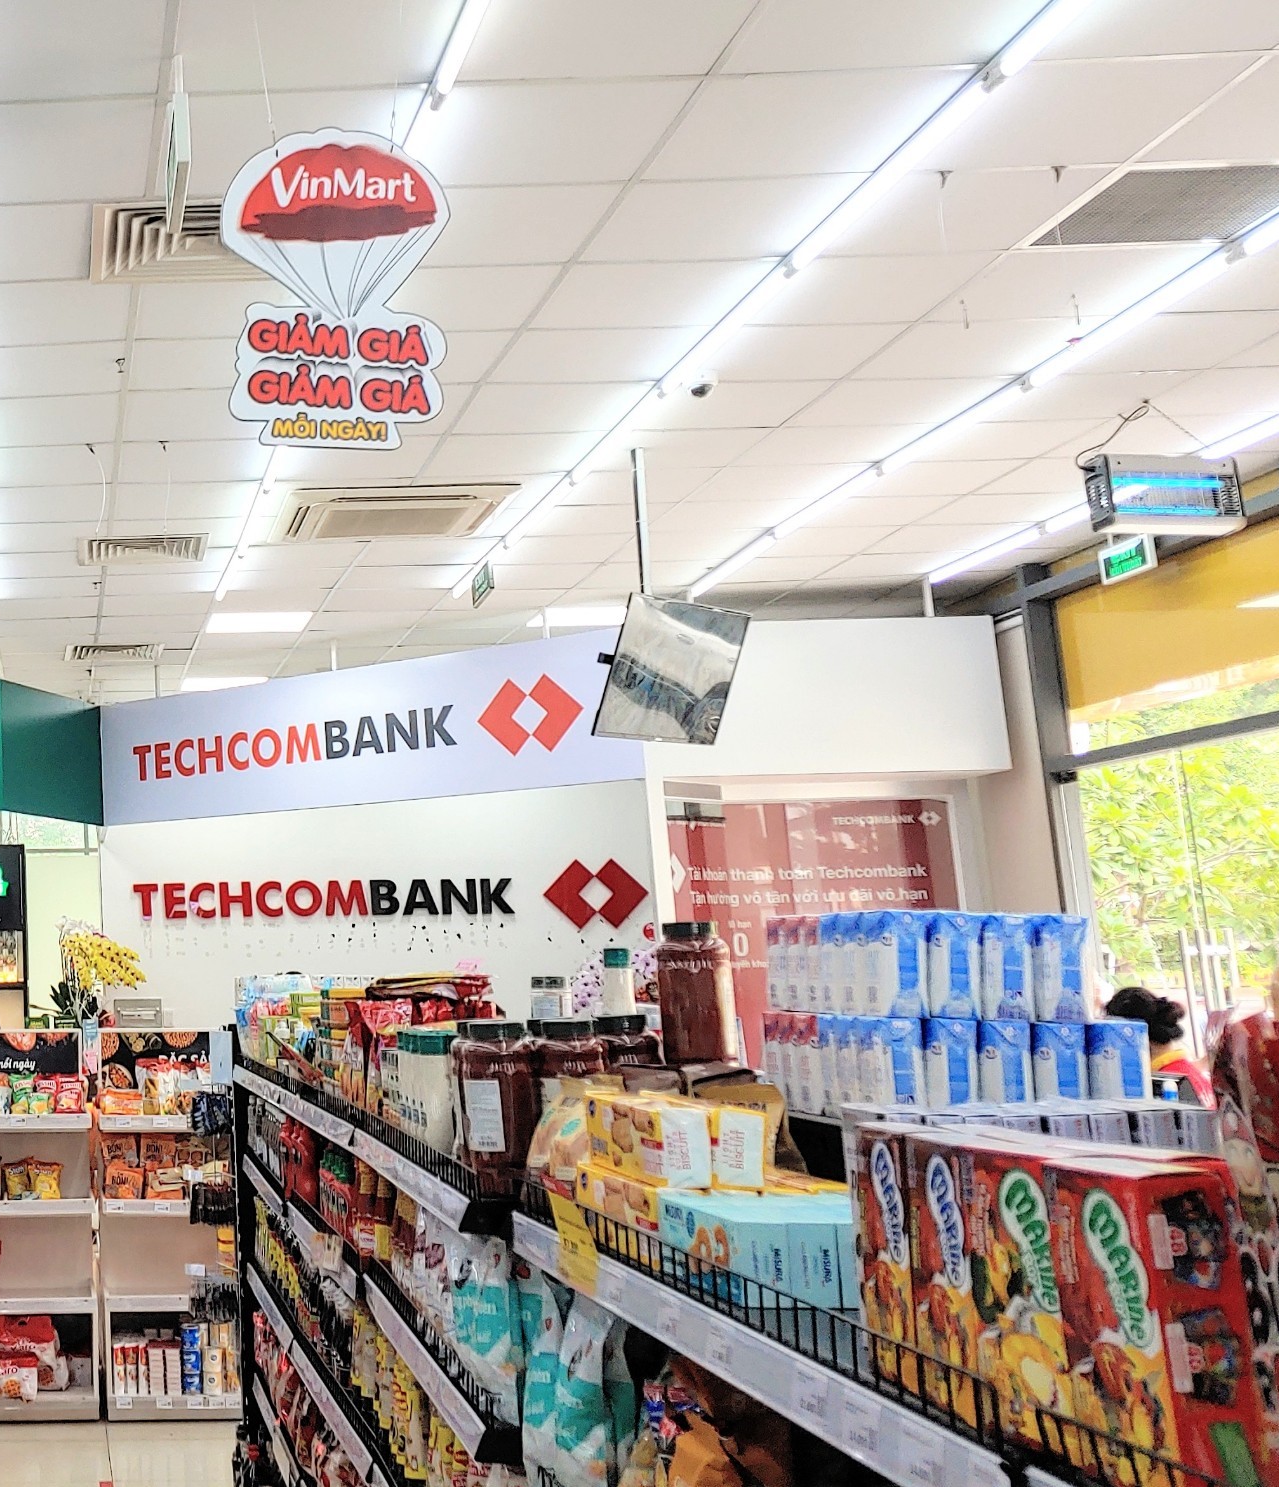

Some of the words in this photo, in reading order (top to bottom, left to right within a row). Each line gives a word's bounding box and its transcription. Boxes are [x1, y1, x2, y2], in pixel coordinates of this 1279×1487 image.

[271, 165, 418, 208] VinMart
[247, 313, 350, 359] GIẢM
[357, 325, 428, 366] GIÁ
[248, 364, 352, 409] GIẢM
[360, 375, 431, 415] GIÁ
[321, 418, 388, 442] NGÀY!
[132, 704, 458, 782] TECHCOMBANK
[832, 814, 917, 826] TECHCOMBANK
[729, 867, 774, 881] thanh
[818, 865, 929, 879] Techcombank
[132, 877, 516, 919] TECHCOMBANK
